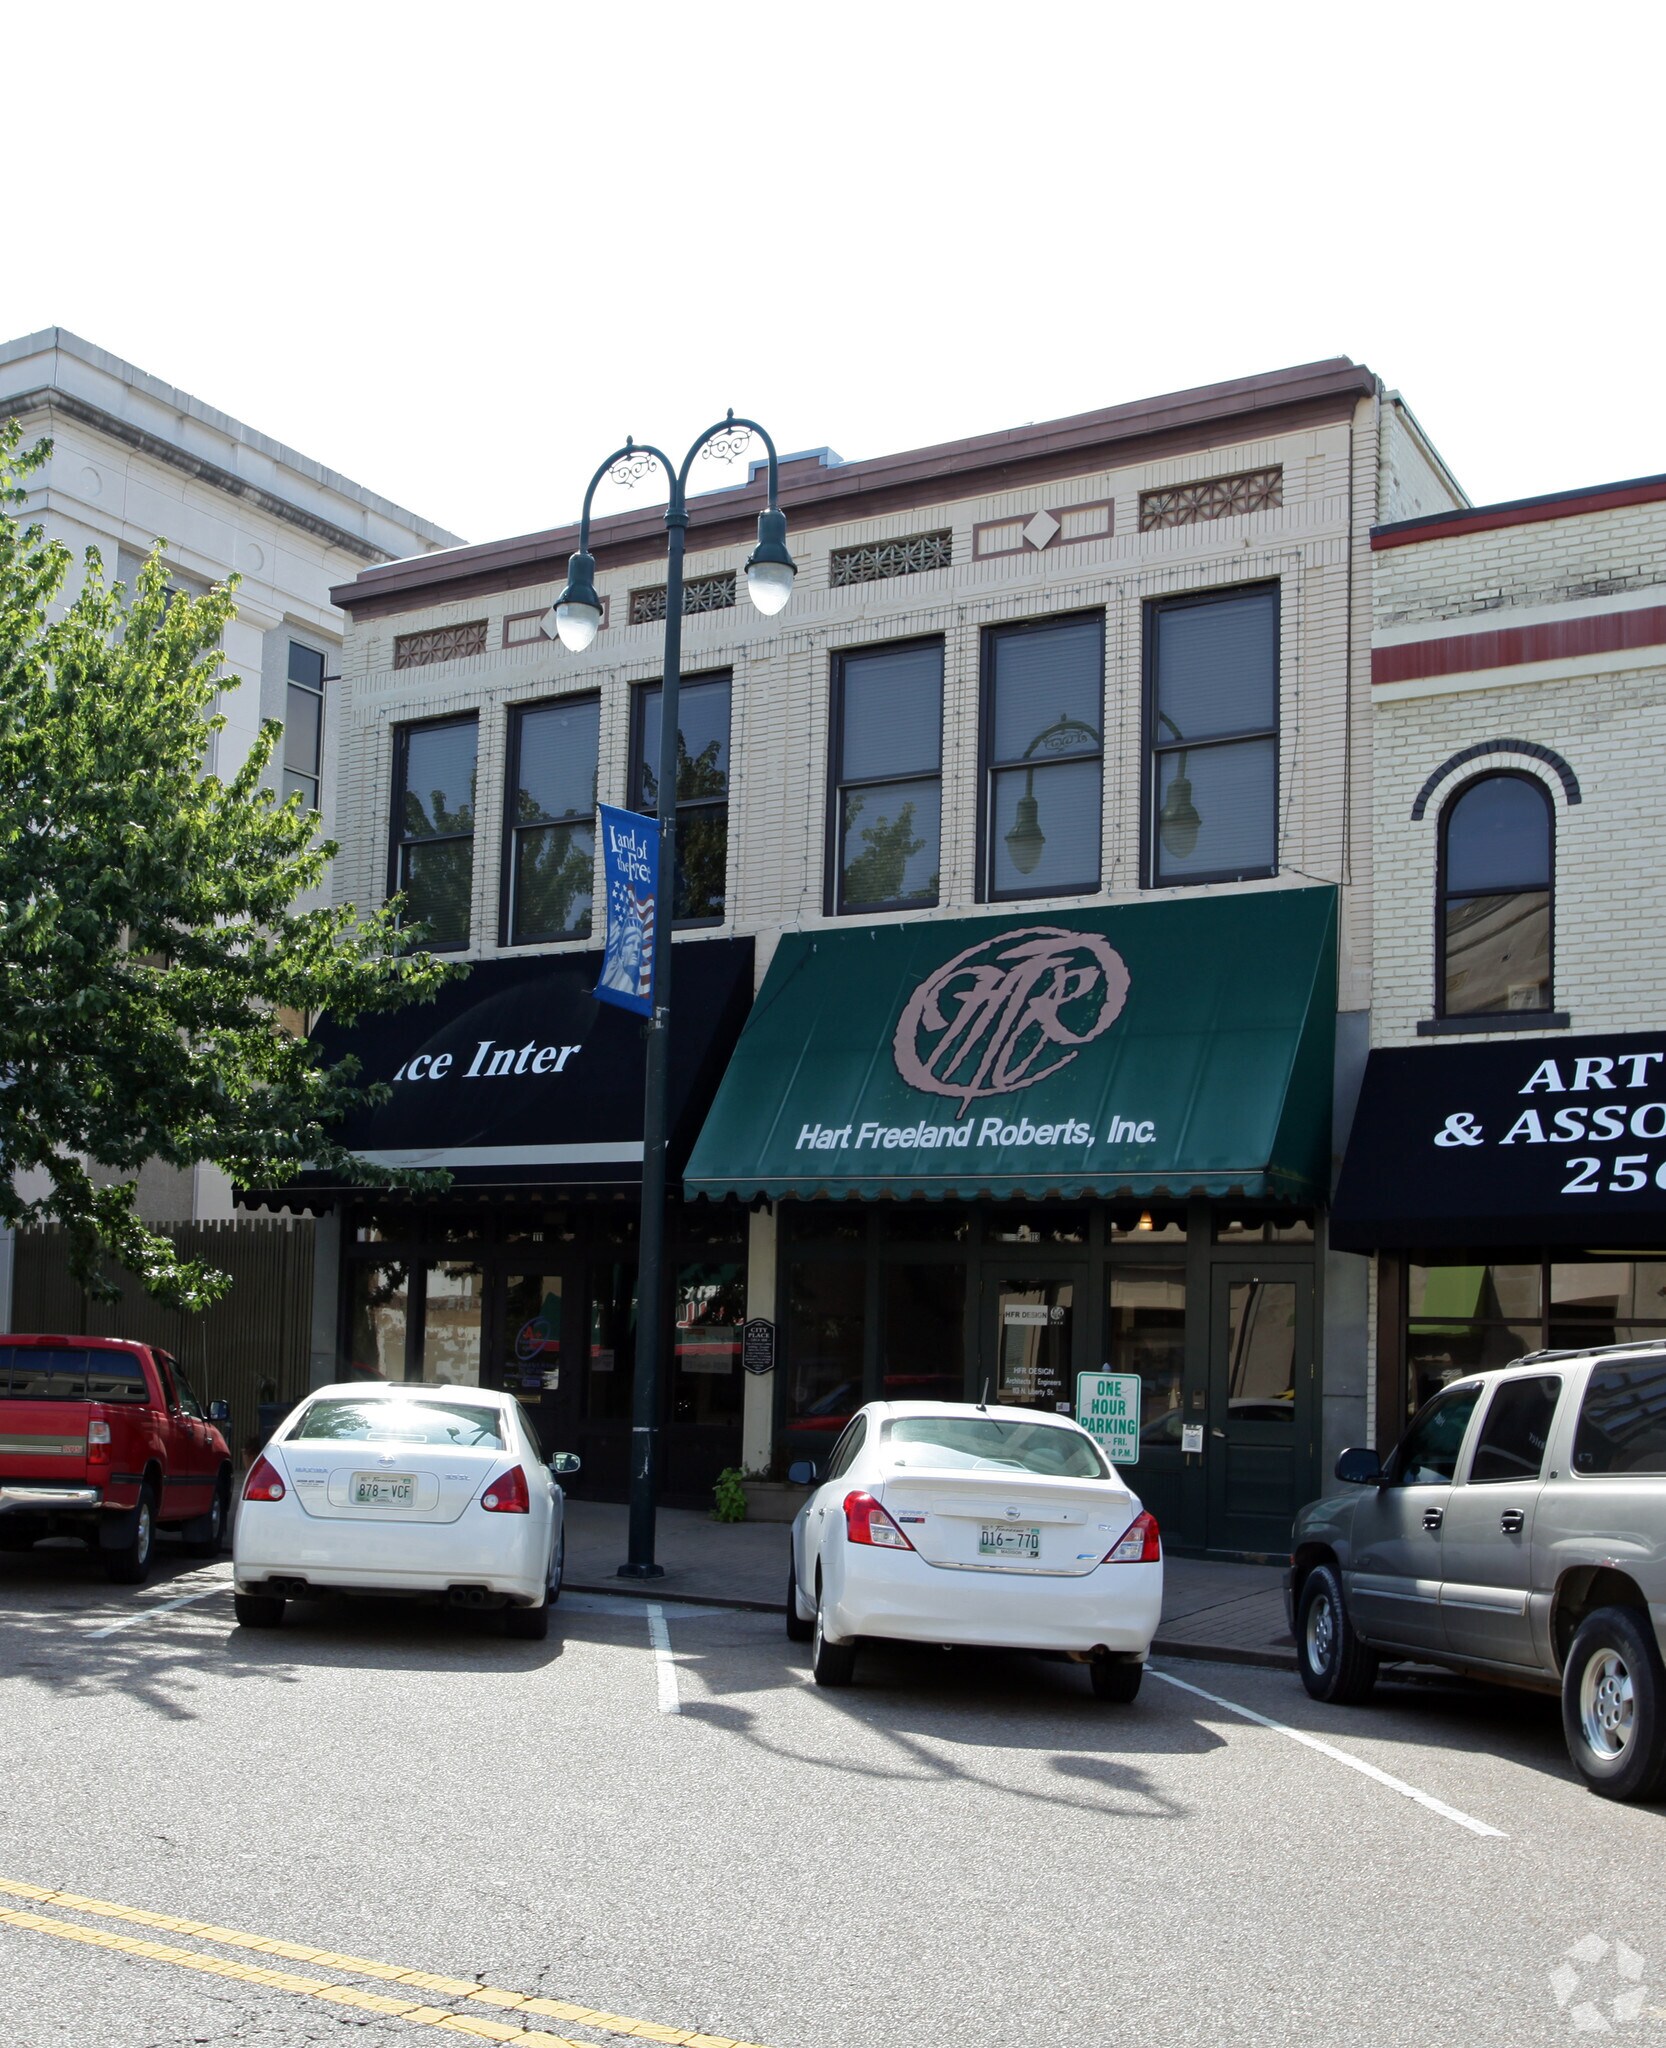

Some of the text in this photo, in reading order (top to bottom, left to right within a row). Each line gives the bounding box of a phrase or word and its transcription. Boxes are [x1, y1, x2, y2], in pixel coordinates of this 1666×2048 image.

[609, 825, 648, 860] Land of
[617, 854, 628, 873] the
[462, 1040, 582, 1078] Inter
[1518, 1052, 1664, 1094] ART
[795, 1115, 1157, 1150] Hart Freeland Roberts, Inc.
[1433, 1102, 1666, 1147] & ASSO
[1022, 1311, 1047, 1319] DESIGN
[1028, 1367, 1055, 1375] DESIGN
[1005, 1377, 1031, 1385] Architects
[1037, 1378, 1062, 1387] Engineers
[1097, 1380, 1122, 1397] ONE
[1027, 1388, 1046, 1397] Liberty
[1091, 1398, 1126, 1416] HOUR
[1081, 1417, 1136, 1435] PARKING
[1113, 1437, 1128, 1446] FRI.
[1111, 1448, 1133, 1457] 4 P.M.
